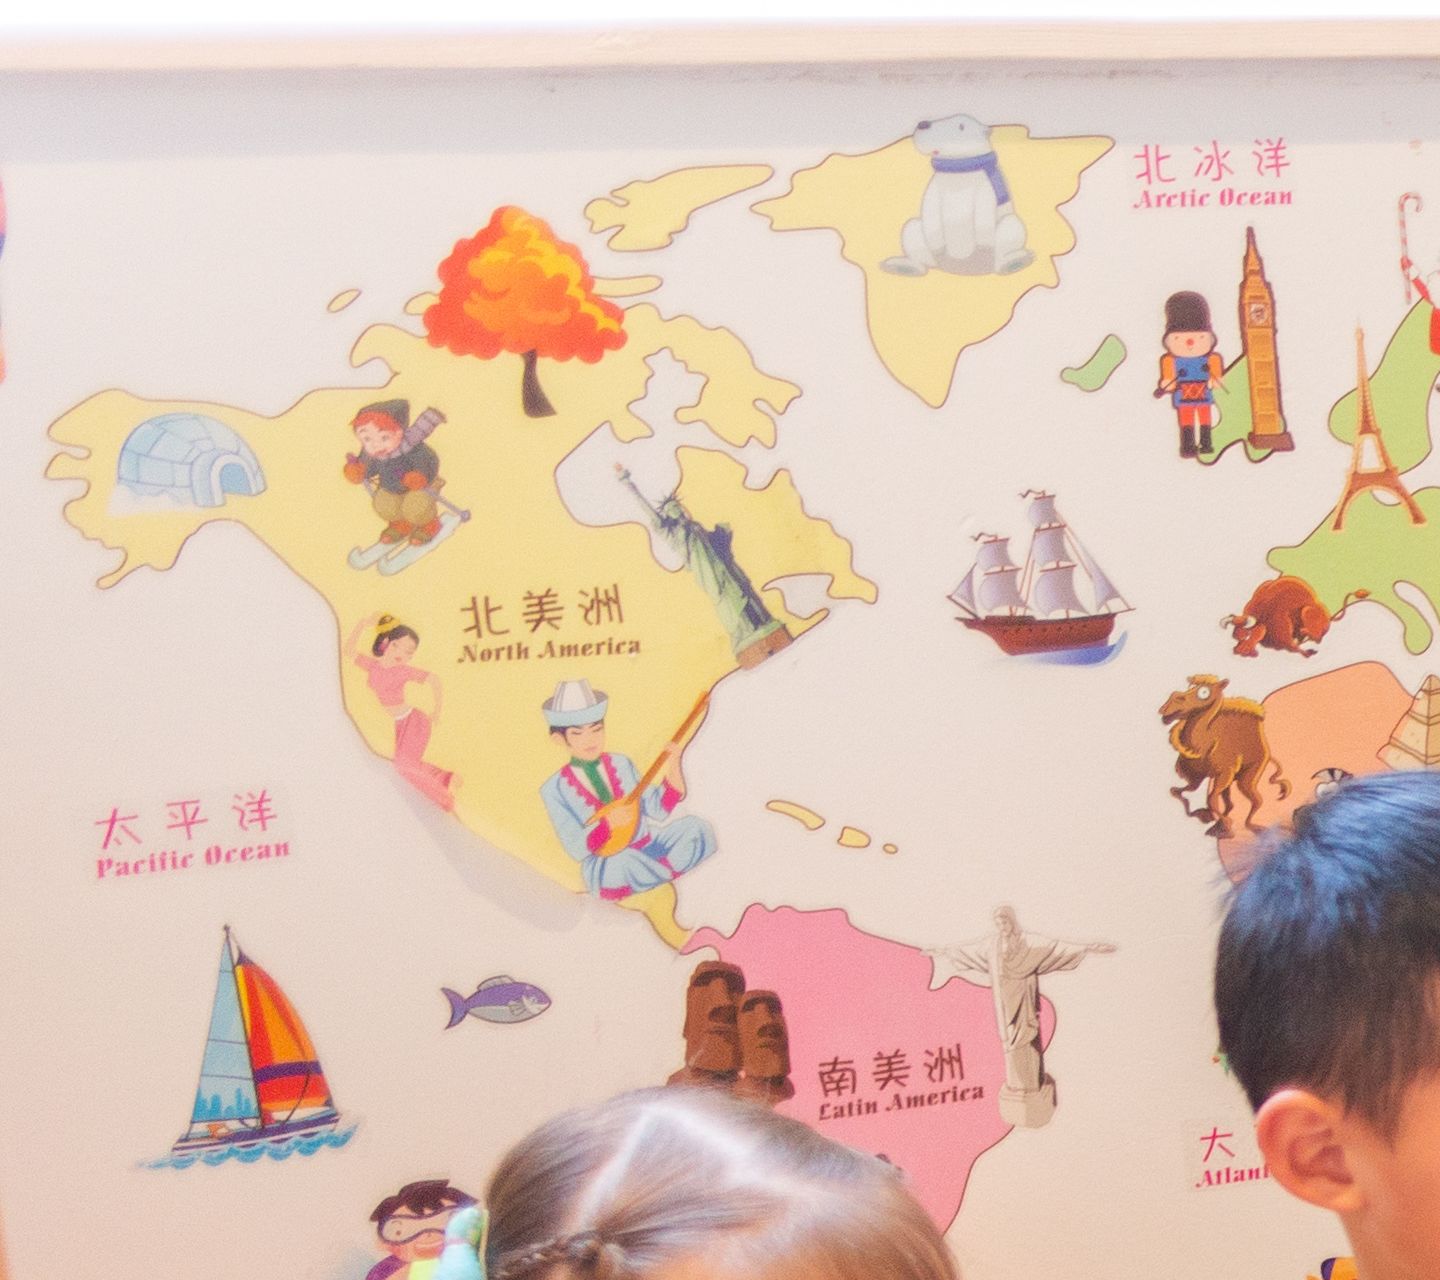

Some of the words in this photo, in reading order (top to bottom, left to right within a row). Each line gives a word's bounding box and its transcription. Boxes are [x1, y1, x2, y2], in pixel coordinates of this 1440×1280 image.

[1133, 137, 1291, 185] 北冰洋
[1133, 189, 1210, 209] Arctic
[1219, 187, 1292, 207] Ocean
[460, 583, 624, 639] 北美洲
[457, 641, 530, 664] North
[537, 637, 641, 659] America
[95, 789, 277, 850] 太平洋
[97, 852, 194, 880] Pacific
[204, 840, 290, 866] Ocean
[818, 1043, 965, 1098] 南美洲
[818, 1098, 878, 1122] Latin
[885, 1085, 984, 1112] America
